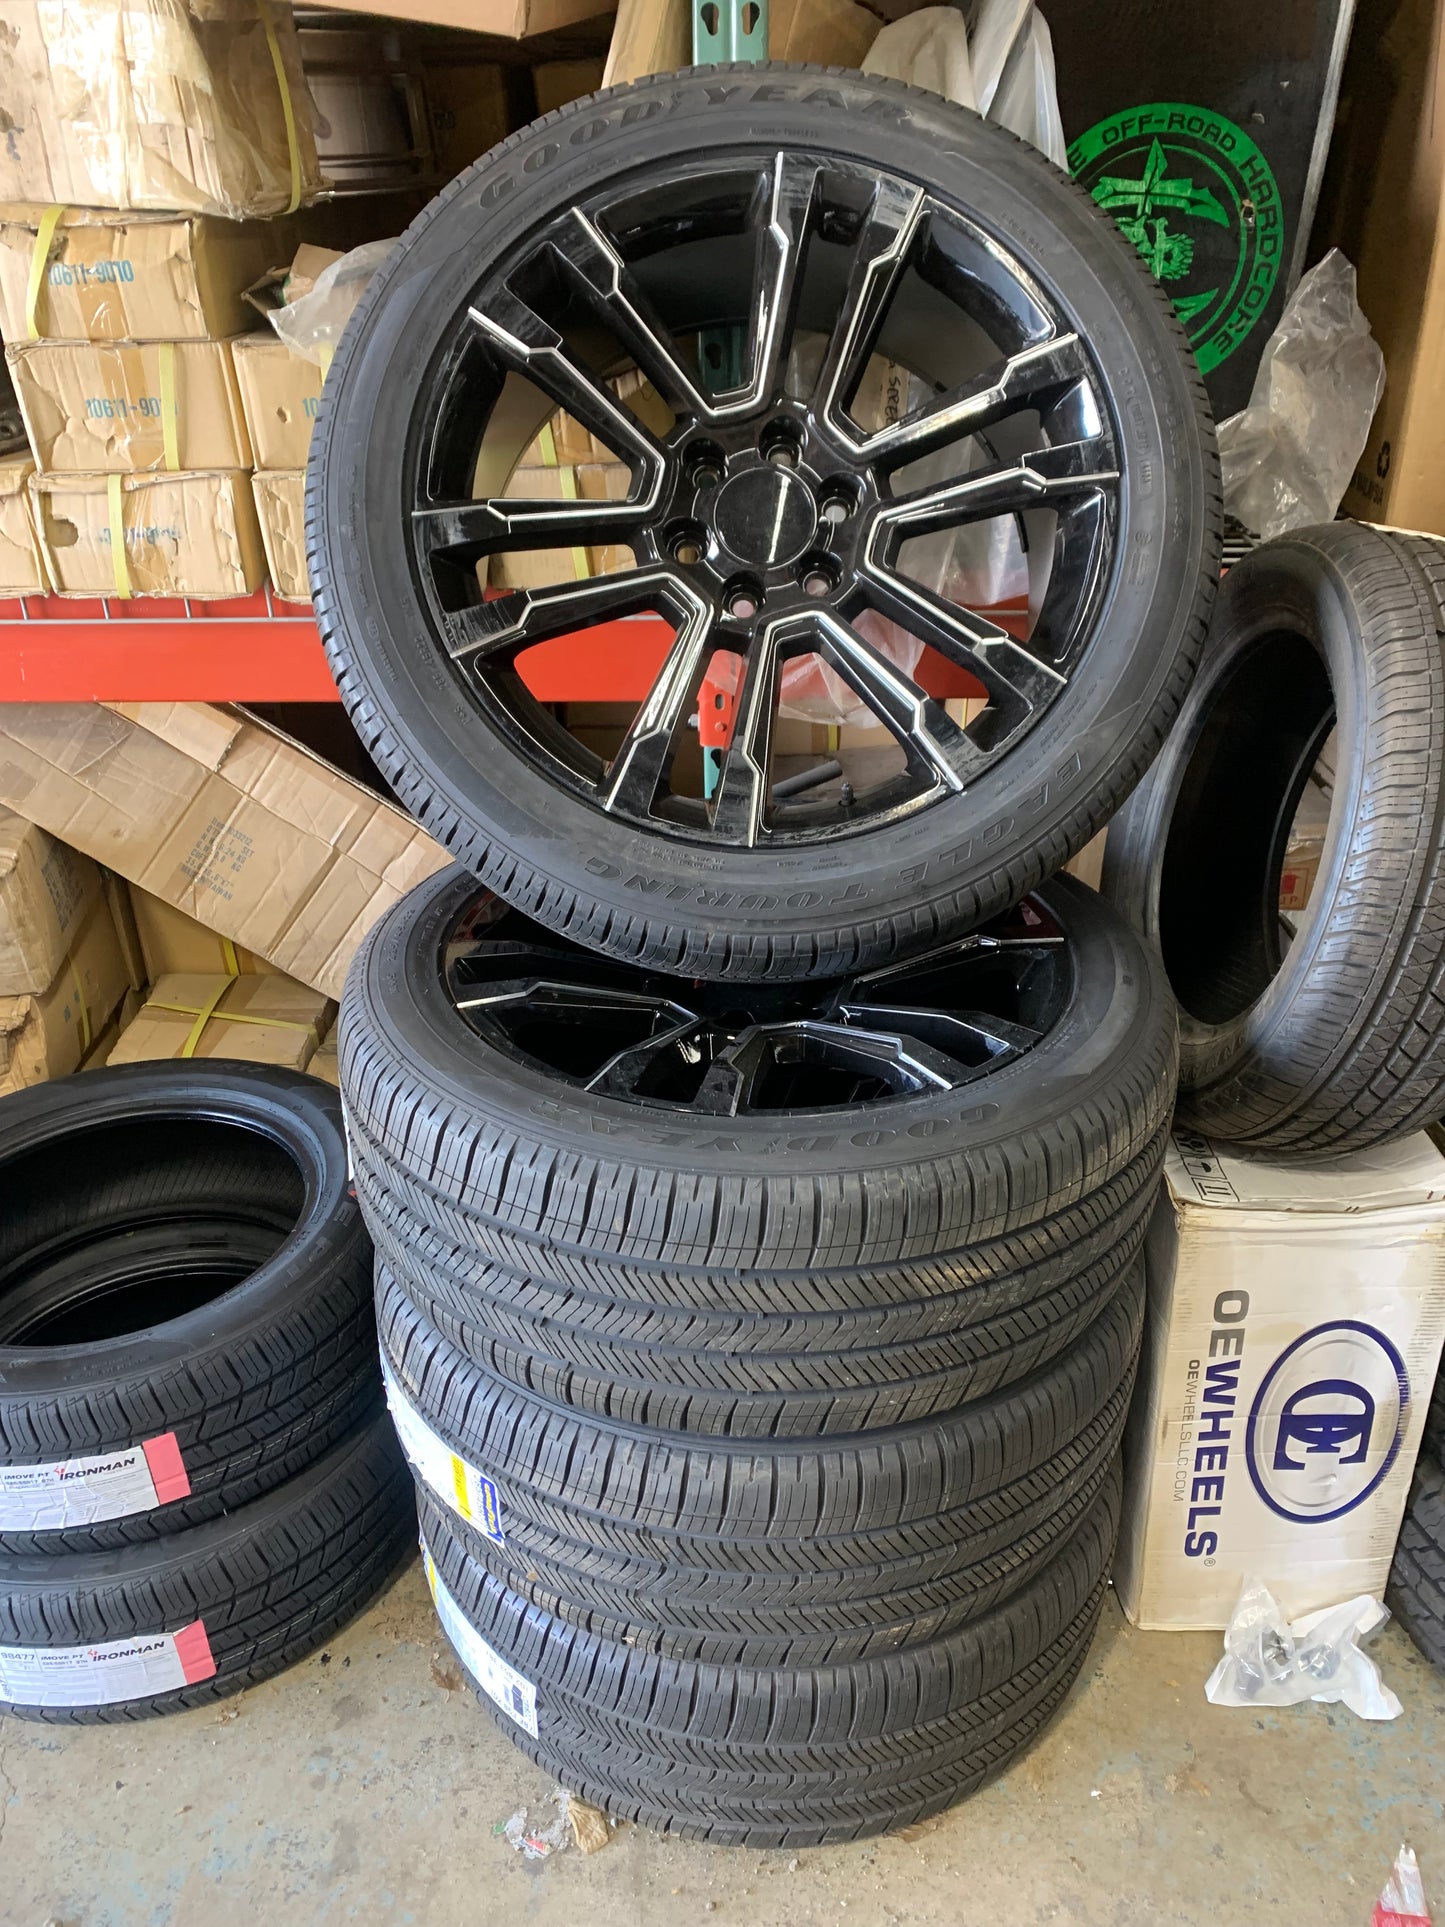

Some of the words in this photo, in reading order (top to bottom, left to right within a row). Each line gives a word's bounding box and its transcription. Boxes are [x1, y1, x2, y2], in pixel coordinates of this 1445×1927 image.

[480, 84, 913, 209] GOODYEAR
[1102, 112, 1237, 153] OFF-ROAD
[1212, 153, 1280, 355] HARDCORE
[898, 750, 1083, 891] EAGLE
[207, 880, 233, 901] TAIWAN
[584, 856, 873, 910] TOURING
[527, 1099, 1001, 1154] GOODYEAR
[1174, 1359, 1201, 1502] OEWHEELSLLC.COM
[59, 1457, 136, 1481] IRONMAN
[92, 1641, 166, 1662] IRONMAN
